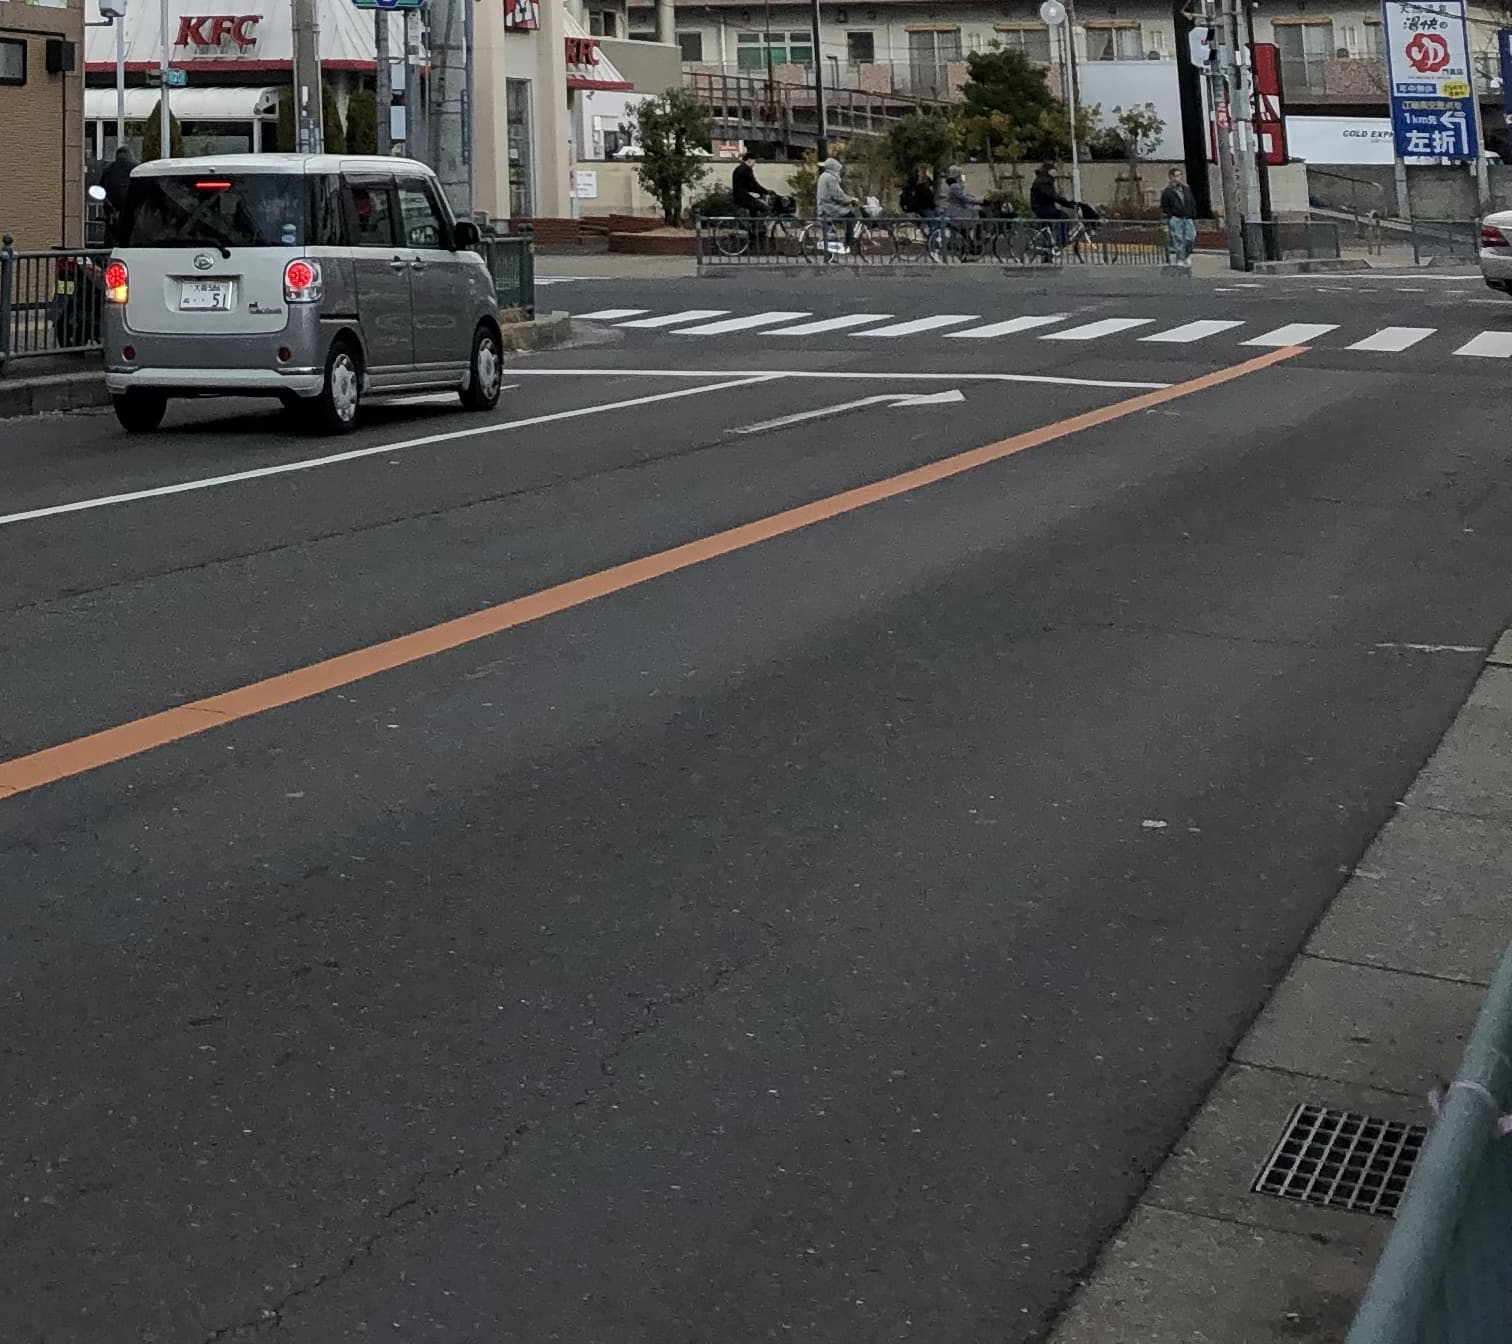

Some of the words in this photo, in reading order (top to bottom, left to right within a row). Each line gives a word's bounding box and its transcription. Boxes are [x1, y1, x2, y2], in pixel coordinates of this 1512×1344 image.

[173, 15, 264, 47] KFC
[564, 37, 601, 66] KFC
[1410, 36, 1445, 69] ゆ
[1342, 129, 1368, 138] COLD
[1405, 129, 1456, 154] 左折
